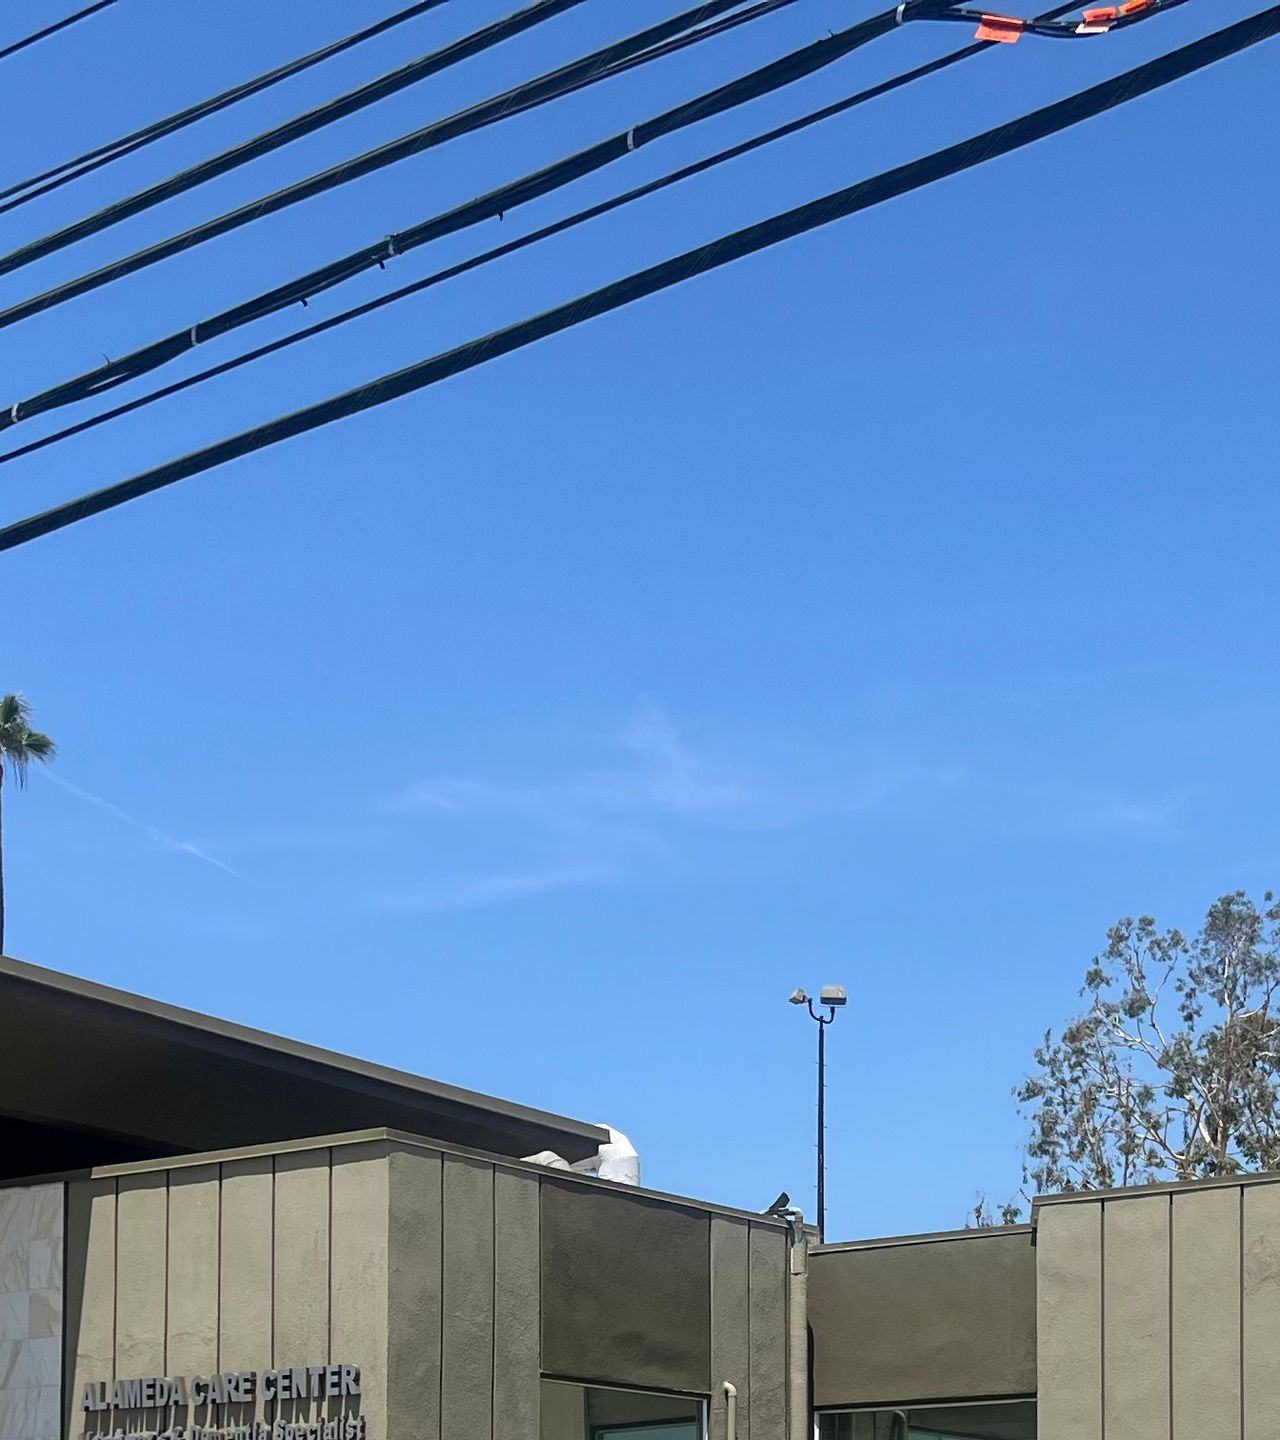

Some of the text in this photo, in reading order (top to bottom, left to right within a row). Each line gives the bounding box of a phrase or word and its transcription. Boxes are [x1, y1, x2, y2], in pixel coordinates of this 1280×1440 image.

[80, 1364, 361, 1412] ALAMEDA CARE CENTER
